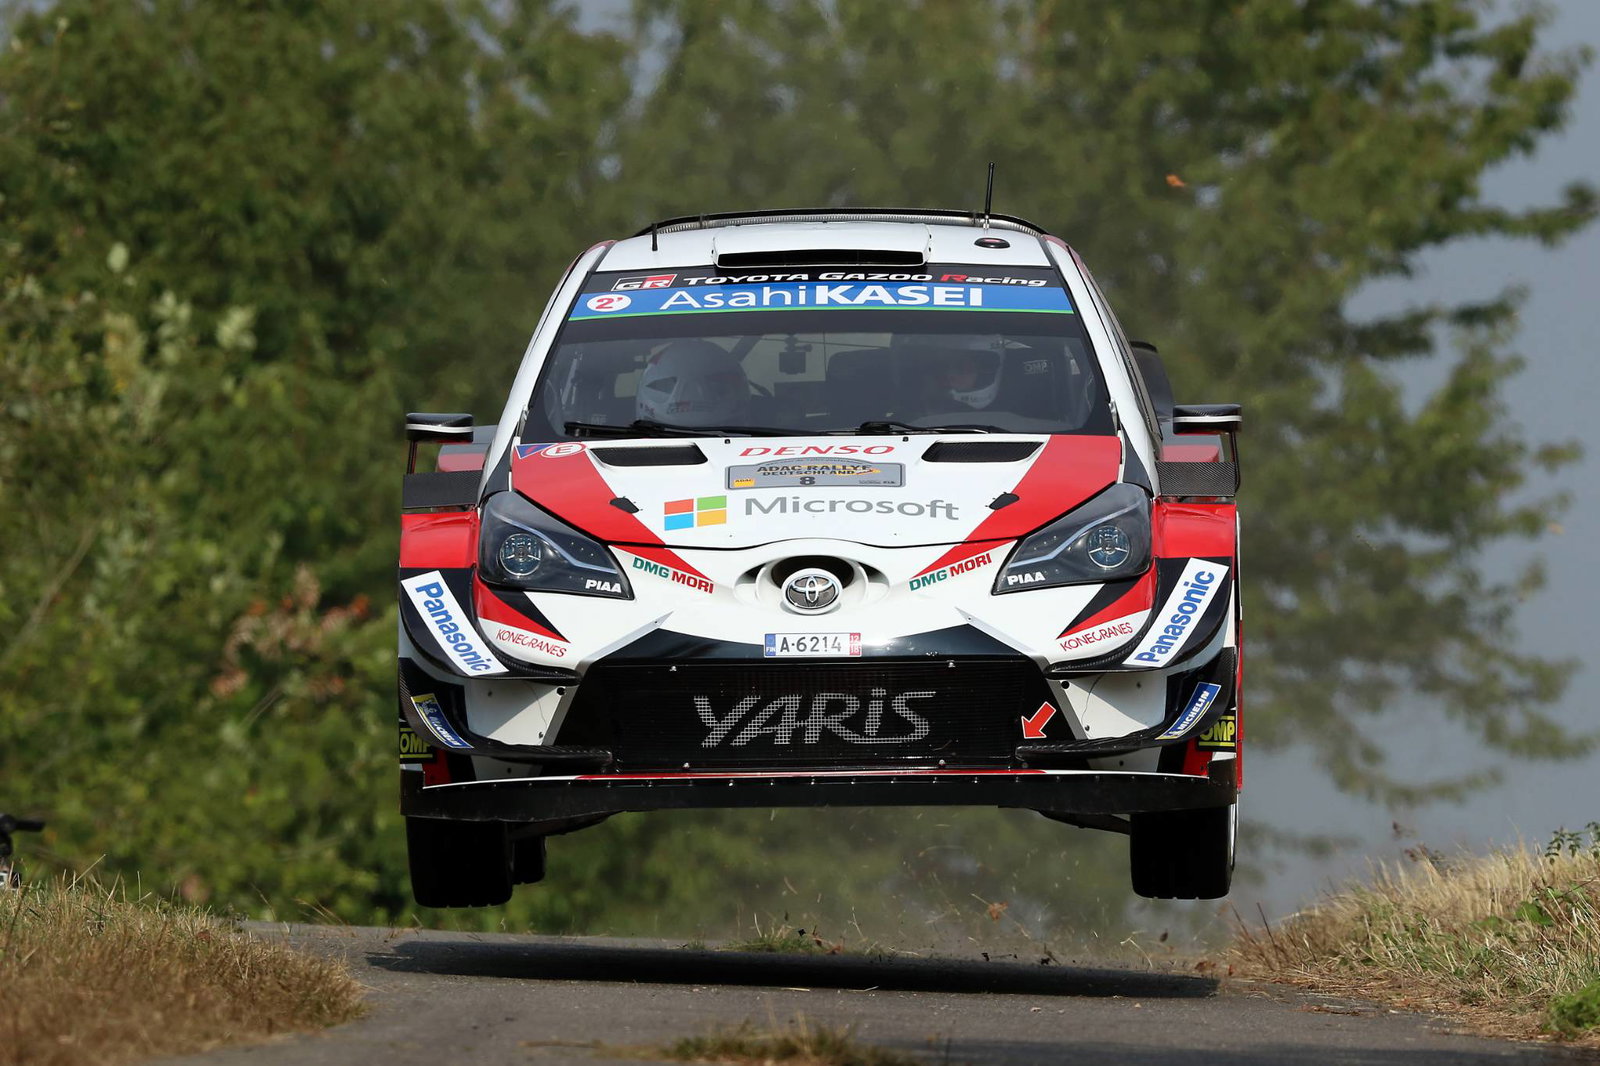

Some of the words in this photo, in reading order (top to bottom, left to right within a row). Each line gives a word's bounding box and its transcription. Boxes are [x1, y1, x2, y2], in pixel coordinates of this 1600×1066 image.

[614, 275, 671, 290] GR
[683, 273, 809, 286] TOYOTA
[818, 272, 933, 281] GAZOO
[940, 274, 1048, 287] Racing
[739, 445, 895, 457] DENSO
[799, 476, 816, 486] 8
[745, 496, 960, 521] Microsoft
[632, 556, 669, 579] DMG
[671, 571, 714, 594] MORI
[908, 569, 948, 592] DMG
[949, 552, 992, 577] MORI
[1007, 571, 1046, 586] PIAA
[585, 579, 622, 594] PIAA
[415, 581, 491, 672] Panasonic
[1134, 570, 1215, 663] Panasonic
[496, 628, 567, 658] KONECRANES
[1060, 621, 1133, 652] KONECRANES
[1177, 690, 1210, 730] MICHELIN
